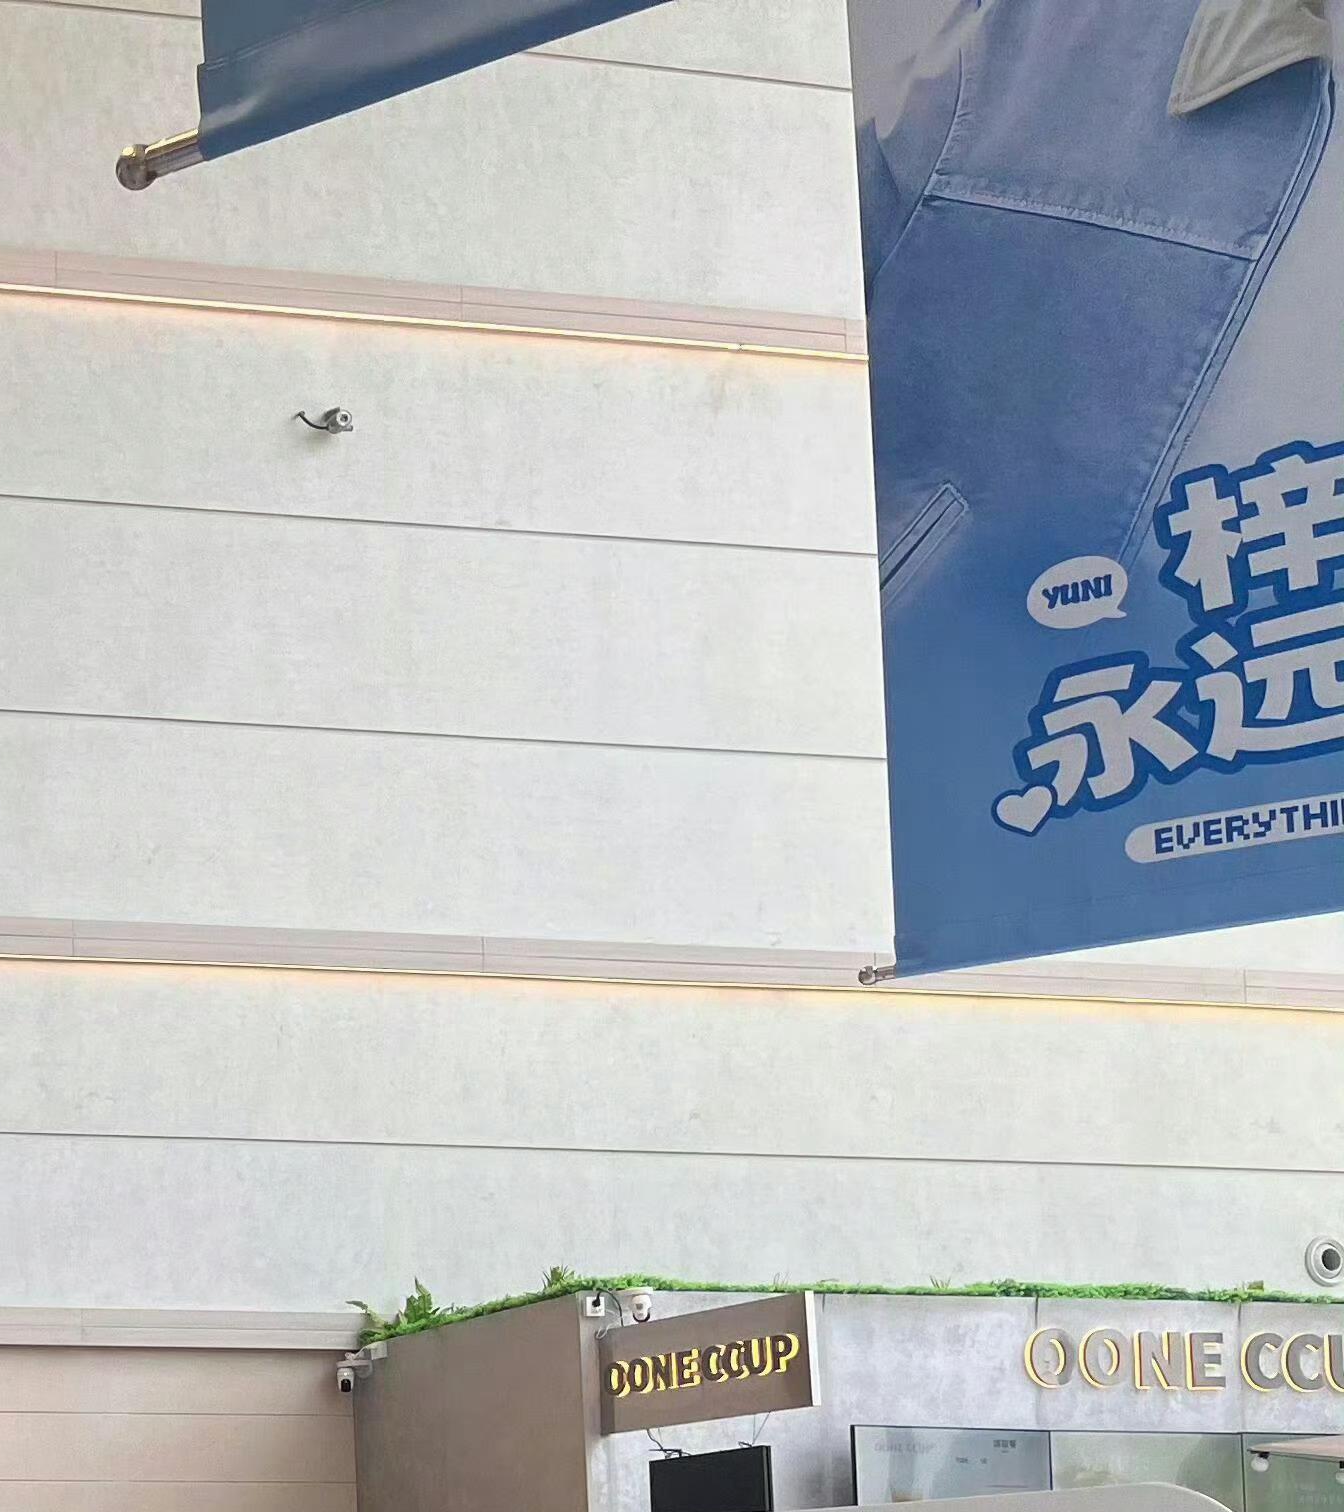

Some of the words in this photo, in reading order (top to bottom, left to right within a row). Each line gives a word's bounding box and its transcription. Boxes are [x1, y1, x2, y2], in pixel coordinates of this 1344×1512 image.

[1041, 573, 1113, 610] YUNI
[1154, 798, 1344, 855] EVERYTHI
[1025, 1327, 1226, 1391] OONE
